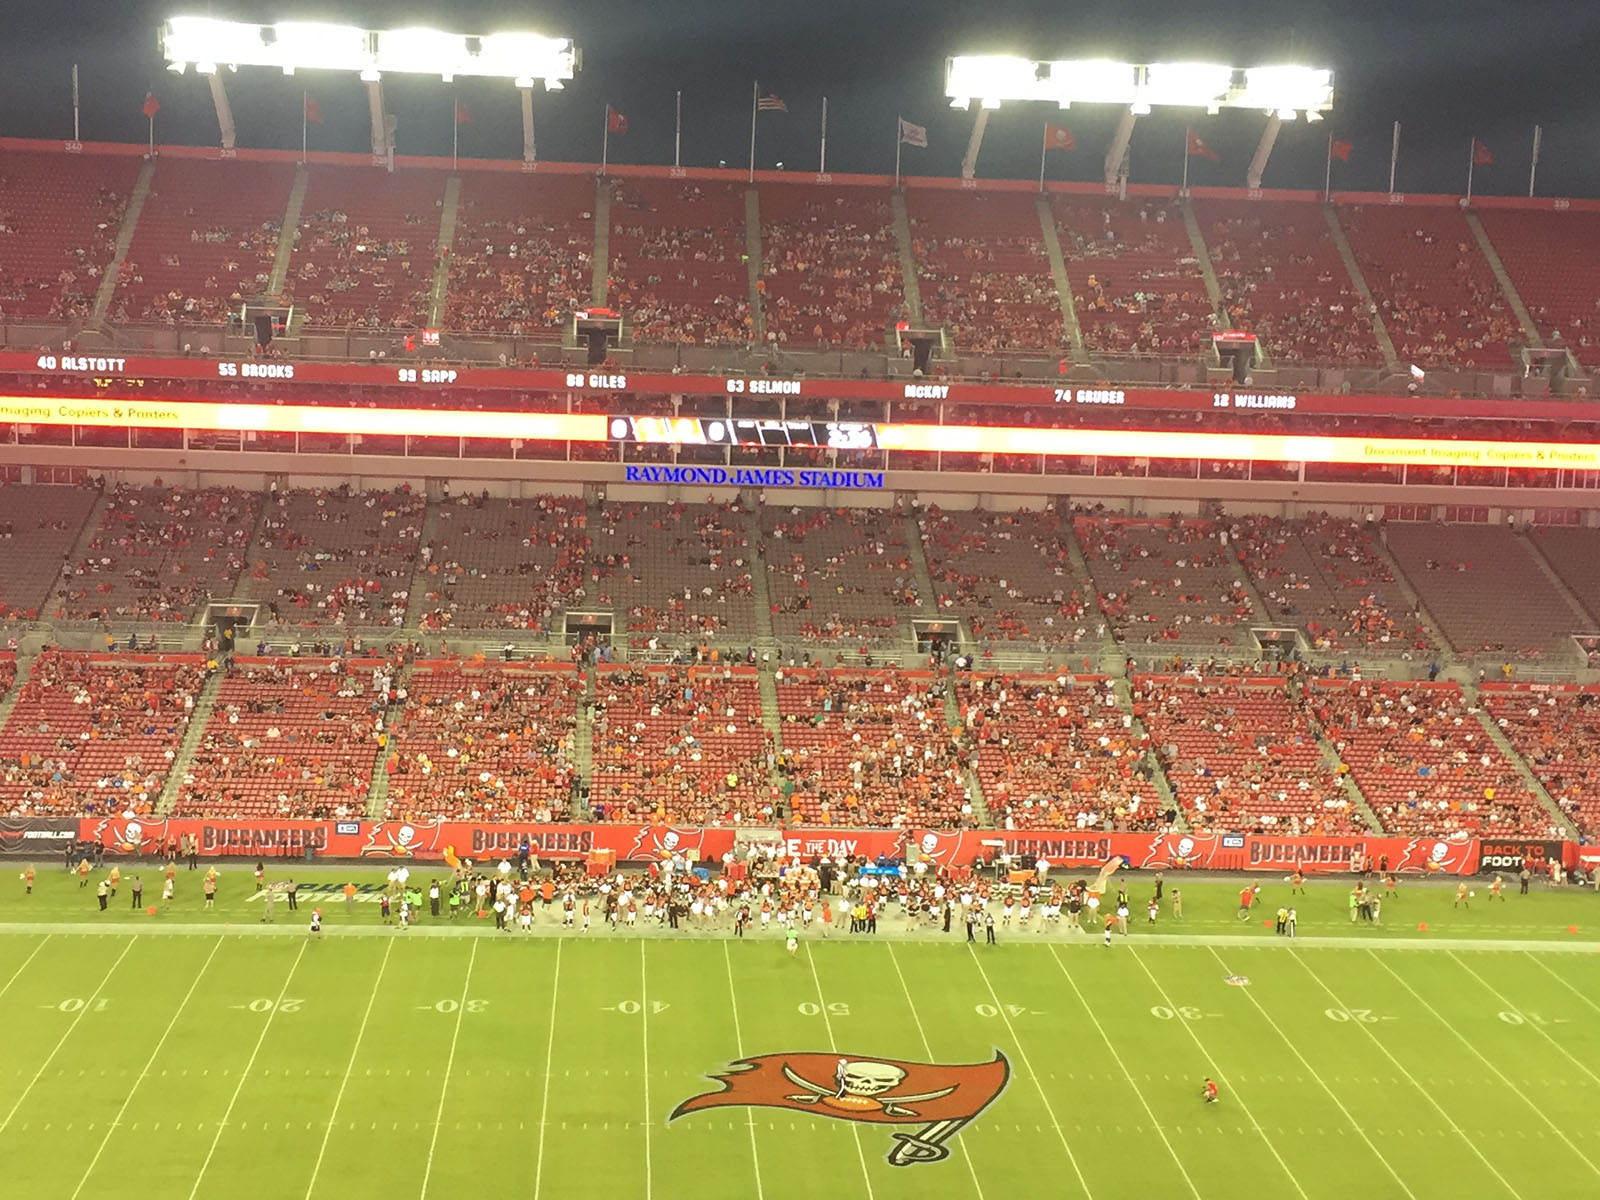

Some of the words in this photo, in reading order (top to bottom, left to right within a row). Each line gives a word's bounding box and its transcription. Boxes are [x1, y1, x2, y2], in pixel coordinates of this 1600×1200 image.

[62, 357, 126, 371] ALSTOTT
[242, 364, 294, 379] BROOKS
[422, 370, 457, 383] SAPP
[590, 375, 627, 388] GILES
[749, 381, 800, 395] SELMON
[1054, 389, 1071, 402] 74
[1235, 395, 1296, 409] WILLIAMS
[113, 408, 123, 418] &
[128, 408, 180, 420] Printers
[627, 466, 727, 485] RAYMOND
[730, 468, 795, 486] JAMES
[799, 471, 884, 489] STADIUM
[203, 826, 328, 851] BUCCANEERS
[805, 842, 825, 853] THE
[828, 839, 858, 857] DAY
[1001, 838, 1111, 862] UCCANEERS
[1483, 846, 1520, 855] BACK
[1525, 846, 1545, 856] TO
[249, 999, 305, 1012] 20
[435, 1000, 489, 1013] 30
[618, 1000, 671, 1014] 40
[798, 1002, 850, 1016] 50
[975, 1003, 1026, 1017] 40
[1150, 1006, 1203, 1019] 30
[1324, 1008, 1379, 1023] 20
